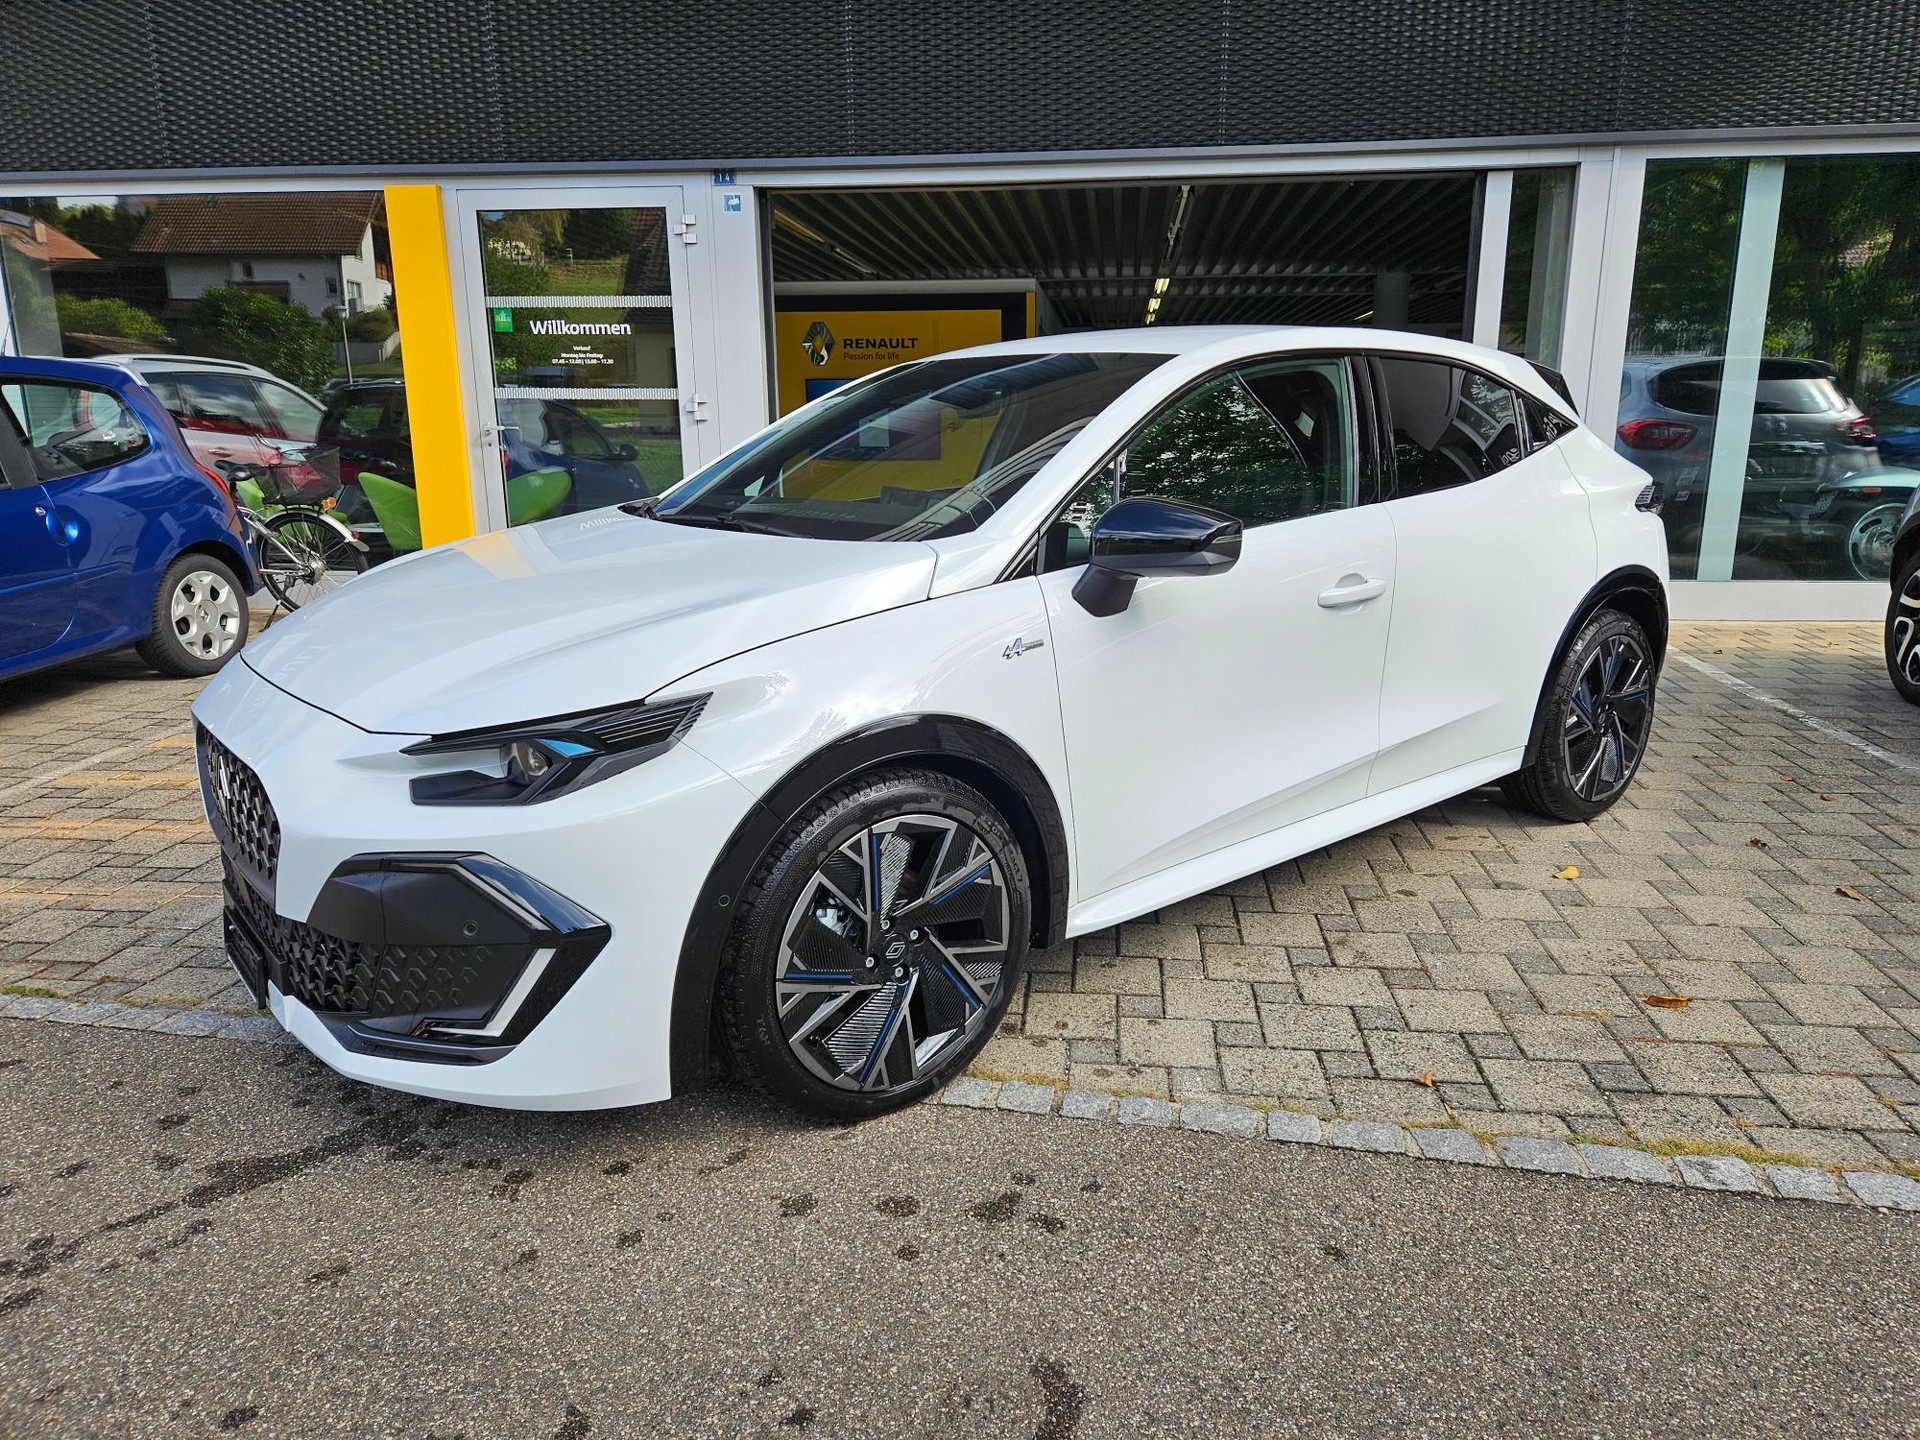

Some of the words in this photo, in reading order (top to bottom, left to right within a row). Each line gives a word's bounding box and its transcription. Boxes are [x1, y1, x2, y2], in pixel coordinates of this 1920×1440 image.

[719, 173, 730, 182] 14
[529, 320, 632, 335] Willkommen
[843, 338, 918, 349] RENAULT
[843, 352, 874, 360] Passion
[875, 352, 886, 360] for
[888, 352, 900, 360] life
